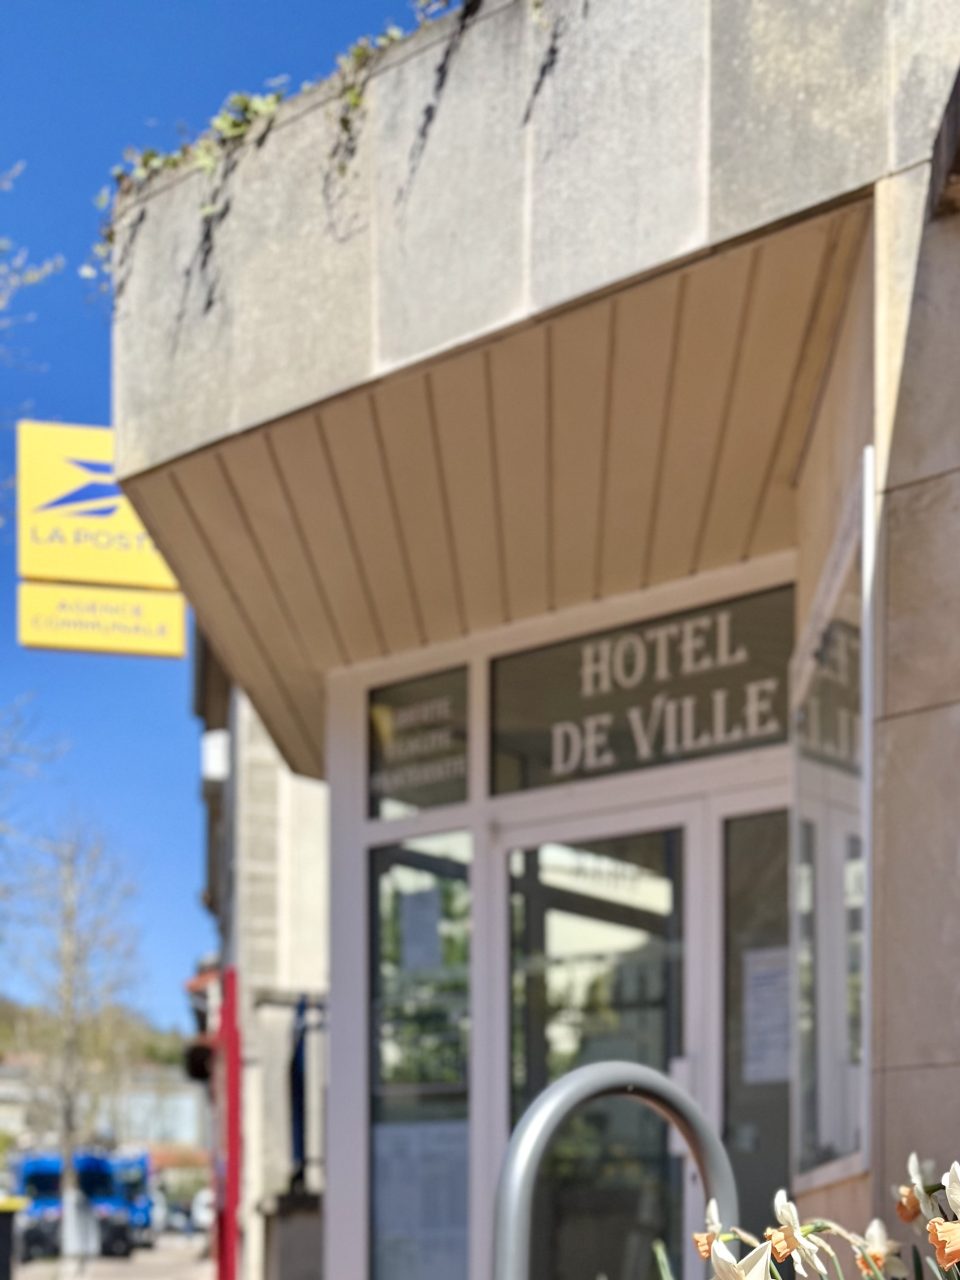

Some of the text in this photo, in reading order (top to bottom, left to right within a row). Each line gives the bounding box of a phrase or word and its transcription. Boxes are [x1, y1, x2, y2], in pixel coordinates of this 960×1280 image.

[31, 526, 153, 554] LA POST
[581, 612, 747, 697] HOTEL
[551, 713, 613, 774] DE
[629, 679, 780, 759] VILLE
